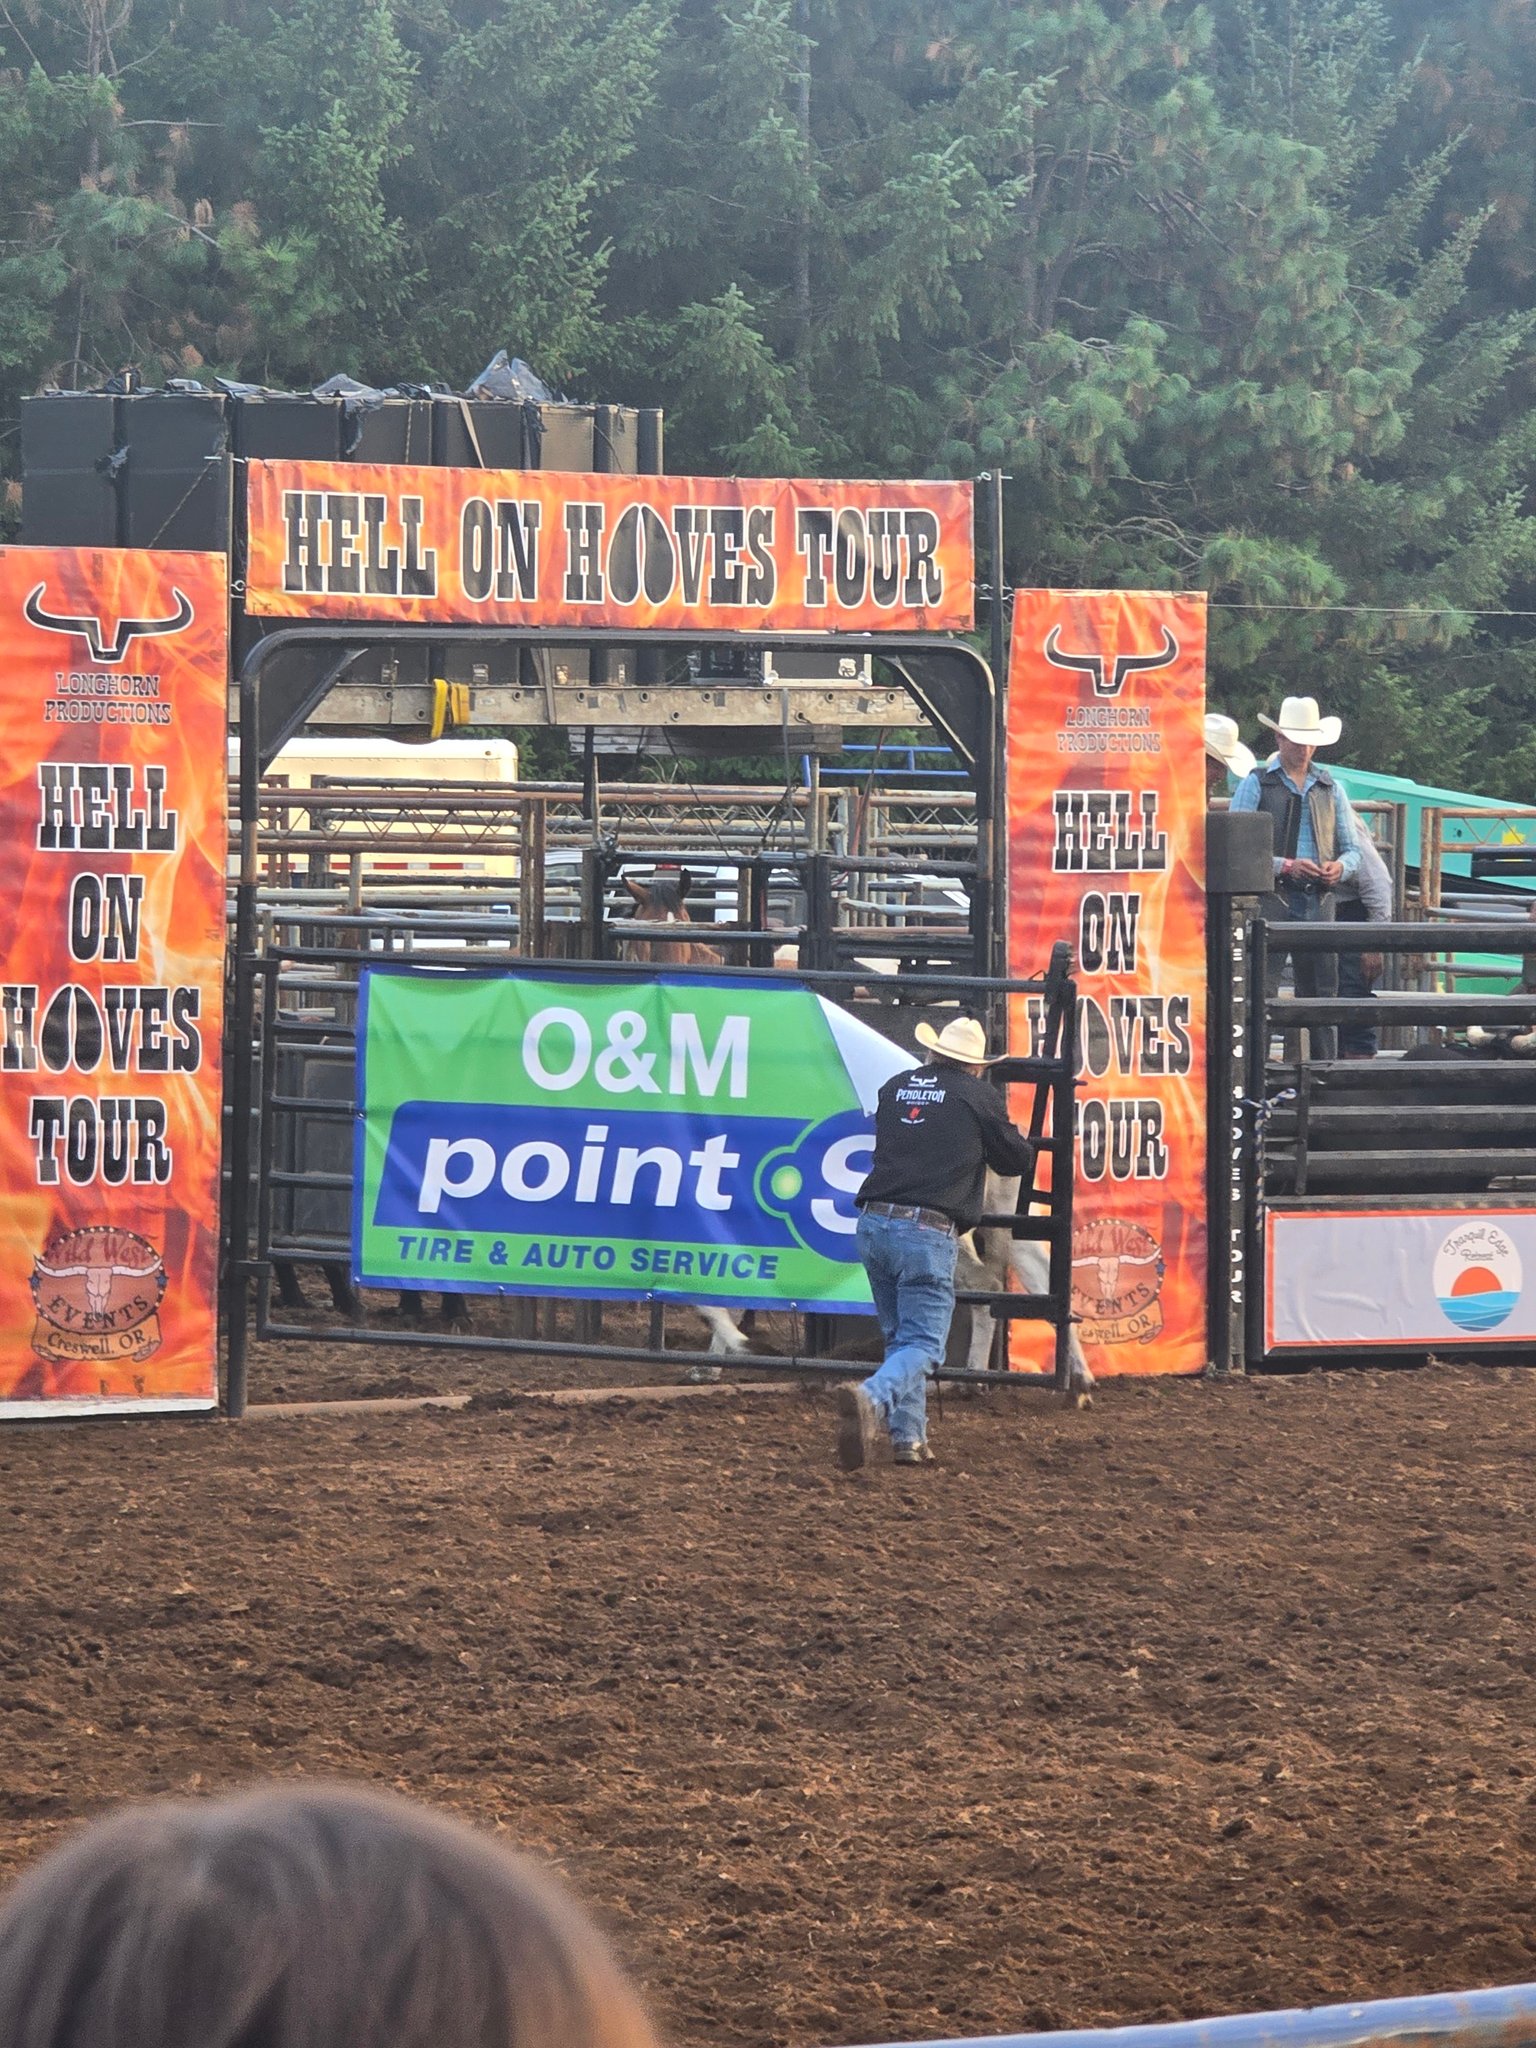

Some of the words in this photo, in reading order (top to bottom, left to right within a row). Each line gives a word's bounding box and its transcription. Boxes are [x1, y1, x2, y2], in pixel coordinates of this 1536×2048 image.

[283, 490, 438, 599] HELL
[460, 496, 541, 602] ON
[563, 501, 776, 607] HOOVES
[796, 507, 943, 609] TOUR
[45, 700, 172, 724] PRODUCTIONS
[56, 673, 160, 696] LONGHORN
[1065, 706, 1151, 727] LONGHORN
[1056, 732, 1161, 752] PRODUCTIONS
[37, 762, 178, 852] HELL
[1052, 790, 1167, 873] HELL
[68, 872, 145, 964] ON
[1078, 891, 1141, 974] ON
[0, 984, 202, 1075] HOOVES
[522, 1006, 751, 1098] O&M
[895, 1088, 946, 1103] PENDLETON
[28, 1096, 173, 1186] TOUR
[417, 1125, 740, 1213] point
[1051, 1098, 1168, 1182] OUR
[397, 1235, 473, 1264] TIRE
[488, 1239, 508, 1266] &
[522, 1242, 616, 1272] AUTO
[630, 1248, 779, 1281] SERVICE
[47, 1295, 149, 1330] EVENTS
[119, 1329, 145, 1349] OR
[1128, 1314, 1151, 1334] OR
